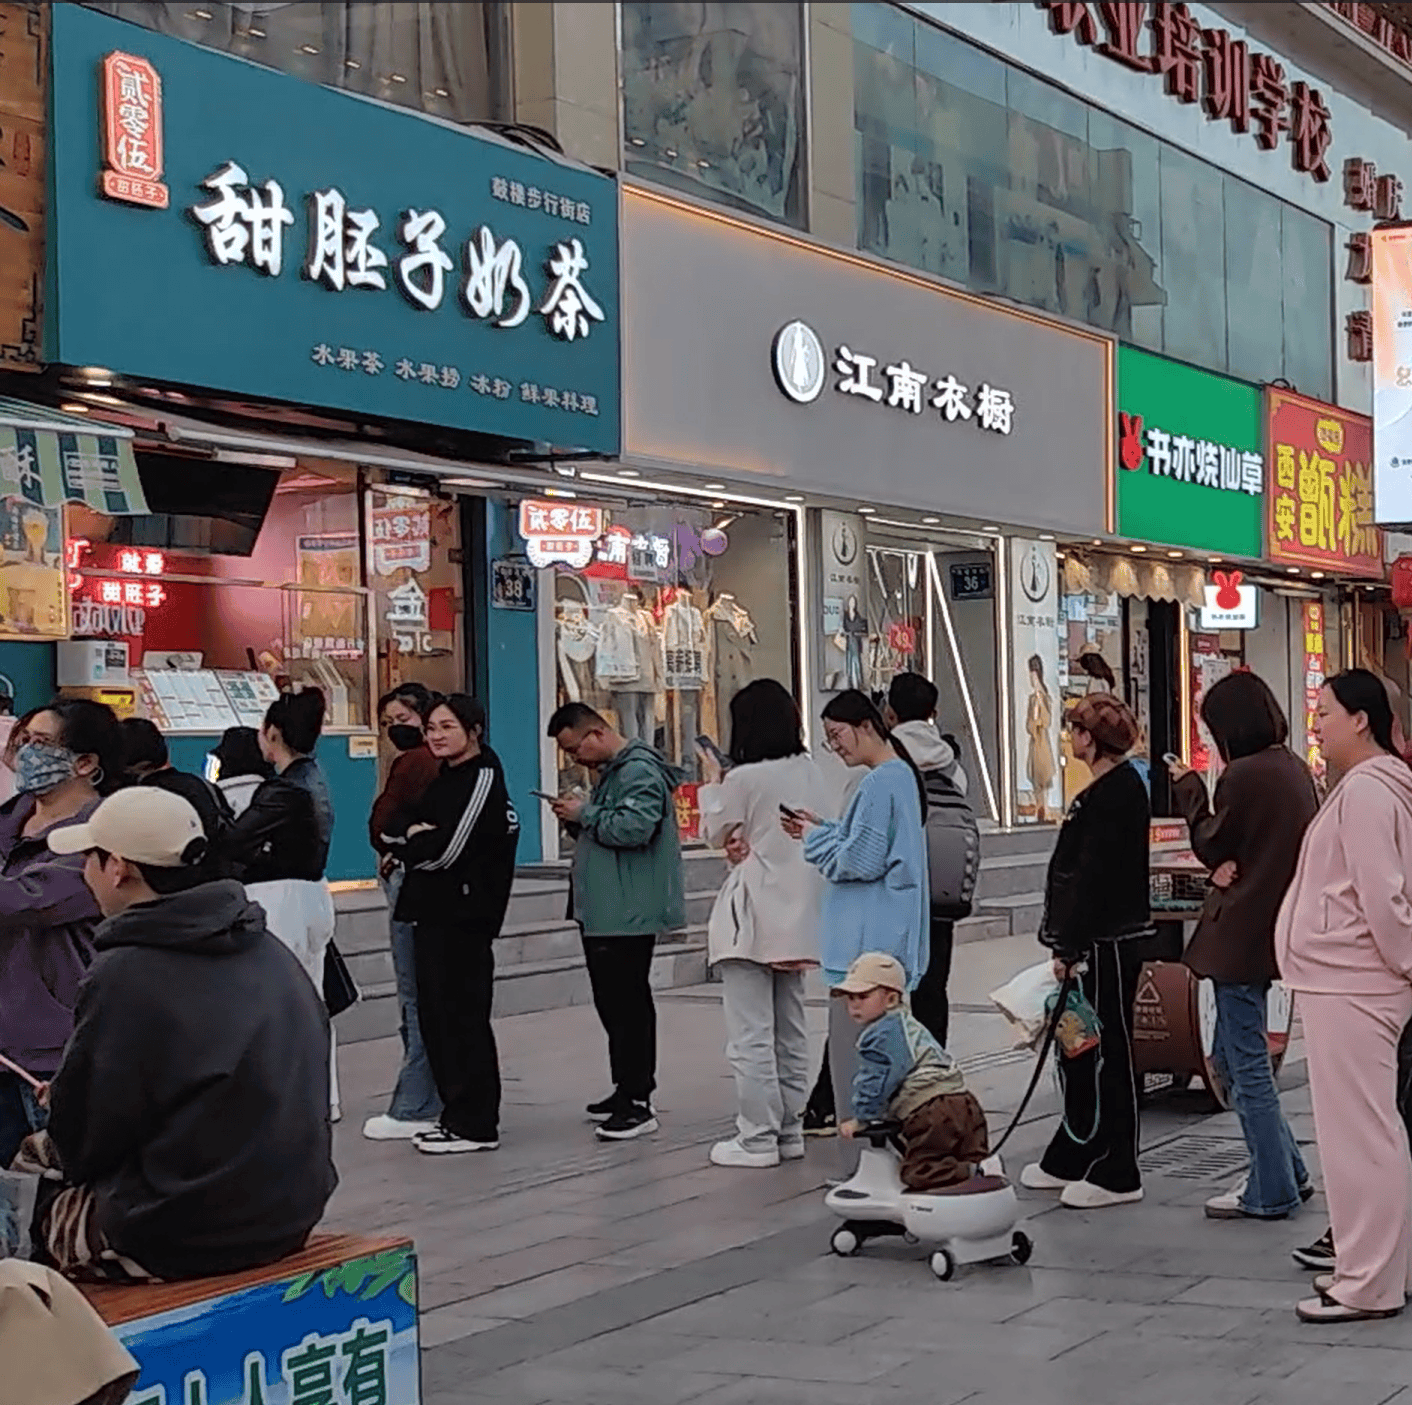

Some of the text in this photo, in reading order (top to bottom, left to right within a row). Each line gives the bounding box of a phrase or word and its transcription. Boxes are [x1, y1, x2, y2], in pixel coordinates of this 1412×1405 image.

[491, 175, 592, 226] 鼓楼步行街店
[193, 161, 606, 342] 甜胚子奶茶
[311, 342, 600, 417] 水果茶 水果捞 冰粉 鲜果料理
[835, 345, 1015, 434] 江南衣橱
[1146, 428, 1263, 495] 书亦烧仙草
[1276, 444, 1296, 541] 西安
[505, 579, 522, 598] 38
[963, 575, 979, 591] 36
